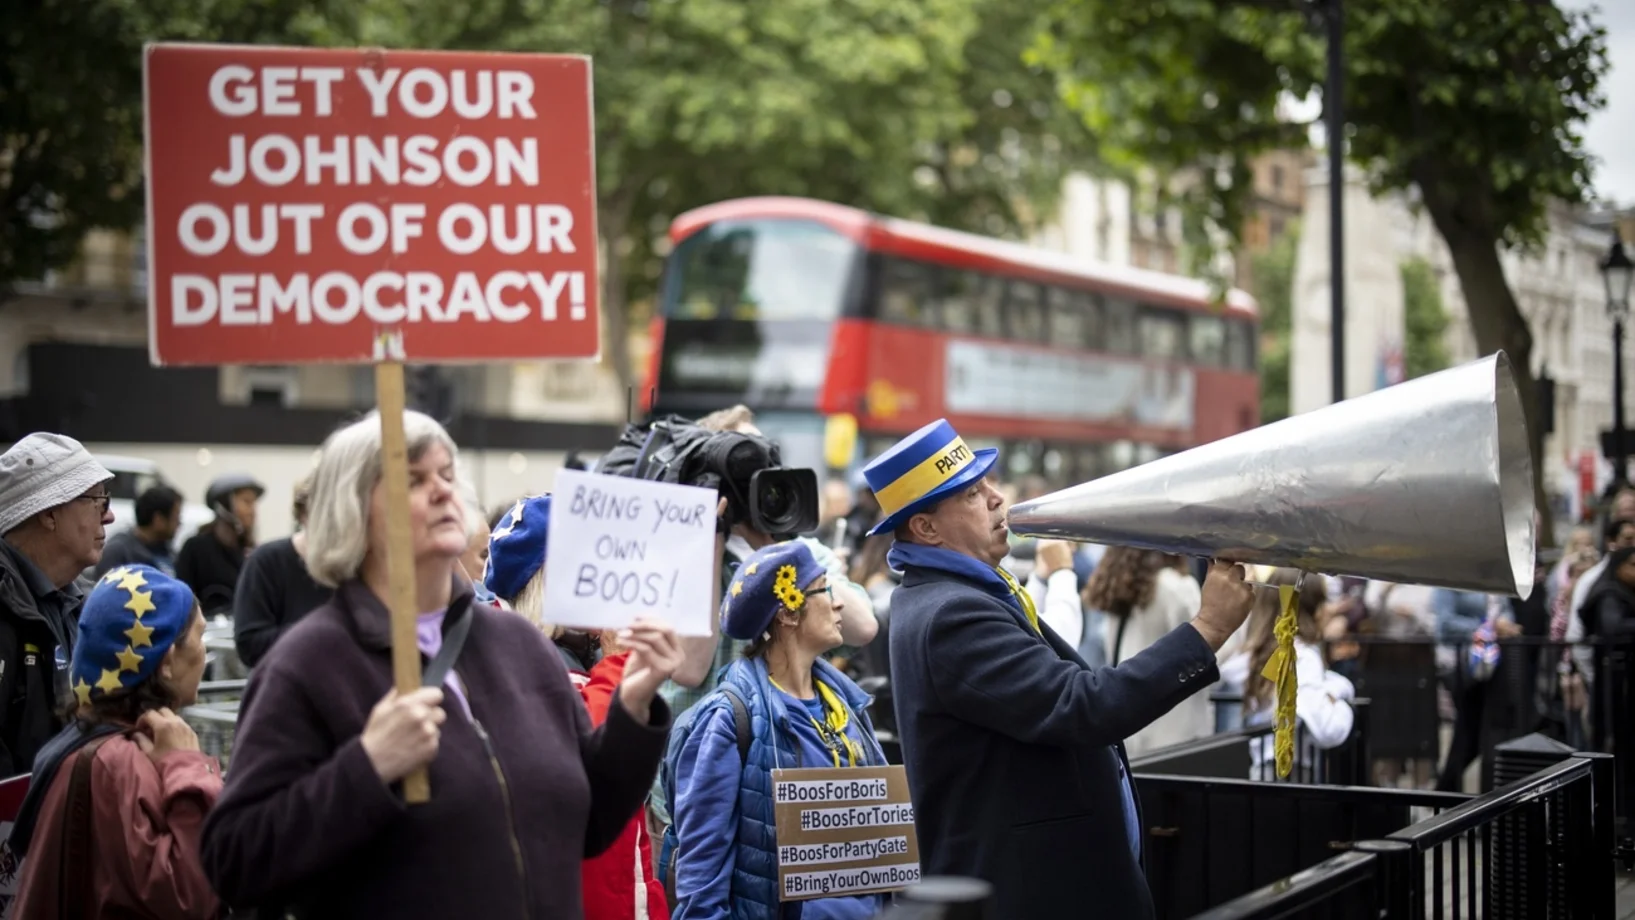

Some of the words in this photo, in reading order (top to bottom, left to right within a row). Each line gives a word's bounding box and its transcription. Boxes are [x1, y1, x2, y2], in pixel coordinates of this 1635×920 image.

[208, 64, 343, 116] GET
[359, 67, 537, 119] YOUR
[210, 133, 540, 187] JOHNSON
[178, 203, 324, 255] OUT
[336, 202, 426, 255] OF
[437, 203, 577, 255] OUR
[171, 271, 587, 327] DEMOCRACY!
[569, 484, 643, 521] BRING
[594, 534, 648, 561] OWN
[574, 563, 680, 608] BOOS!
[777, 779, 886, 801] #BoosForBoris
[801, 805, 914, 829] #BoosForTories
[780, 838, 907, 863] #BoosForPartyGate
[785, 867, 920, 893] #BringYourOwnBoos
